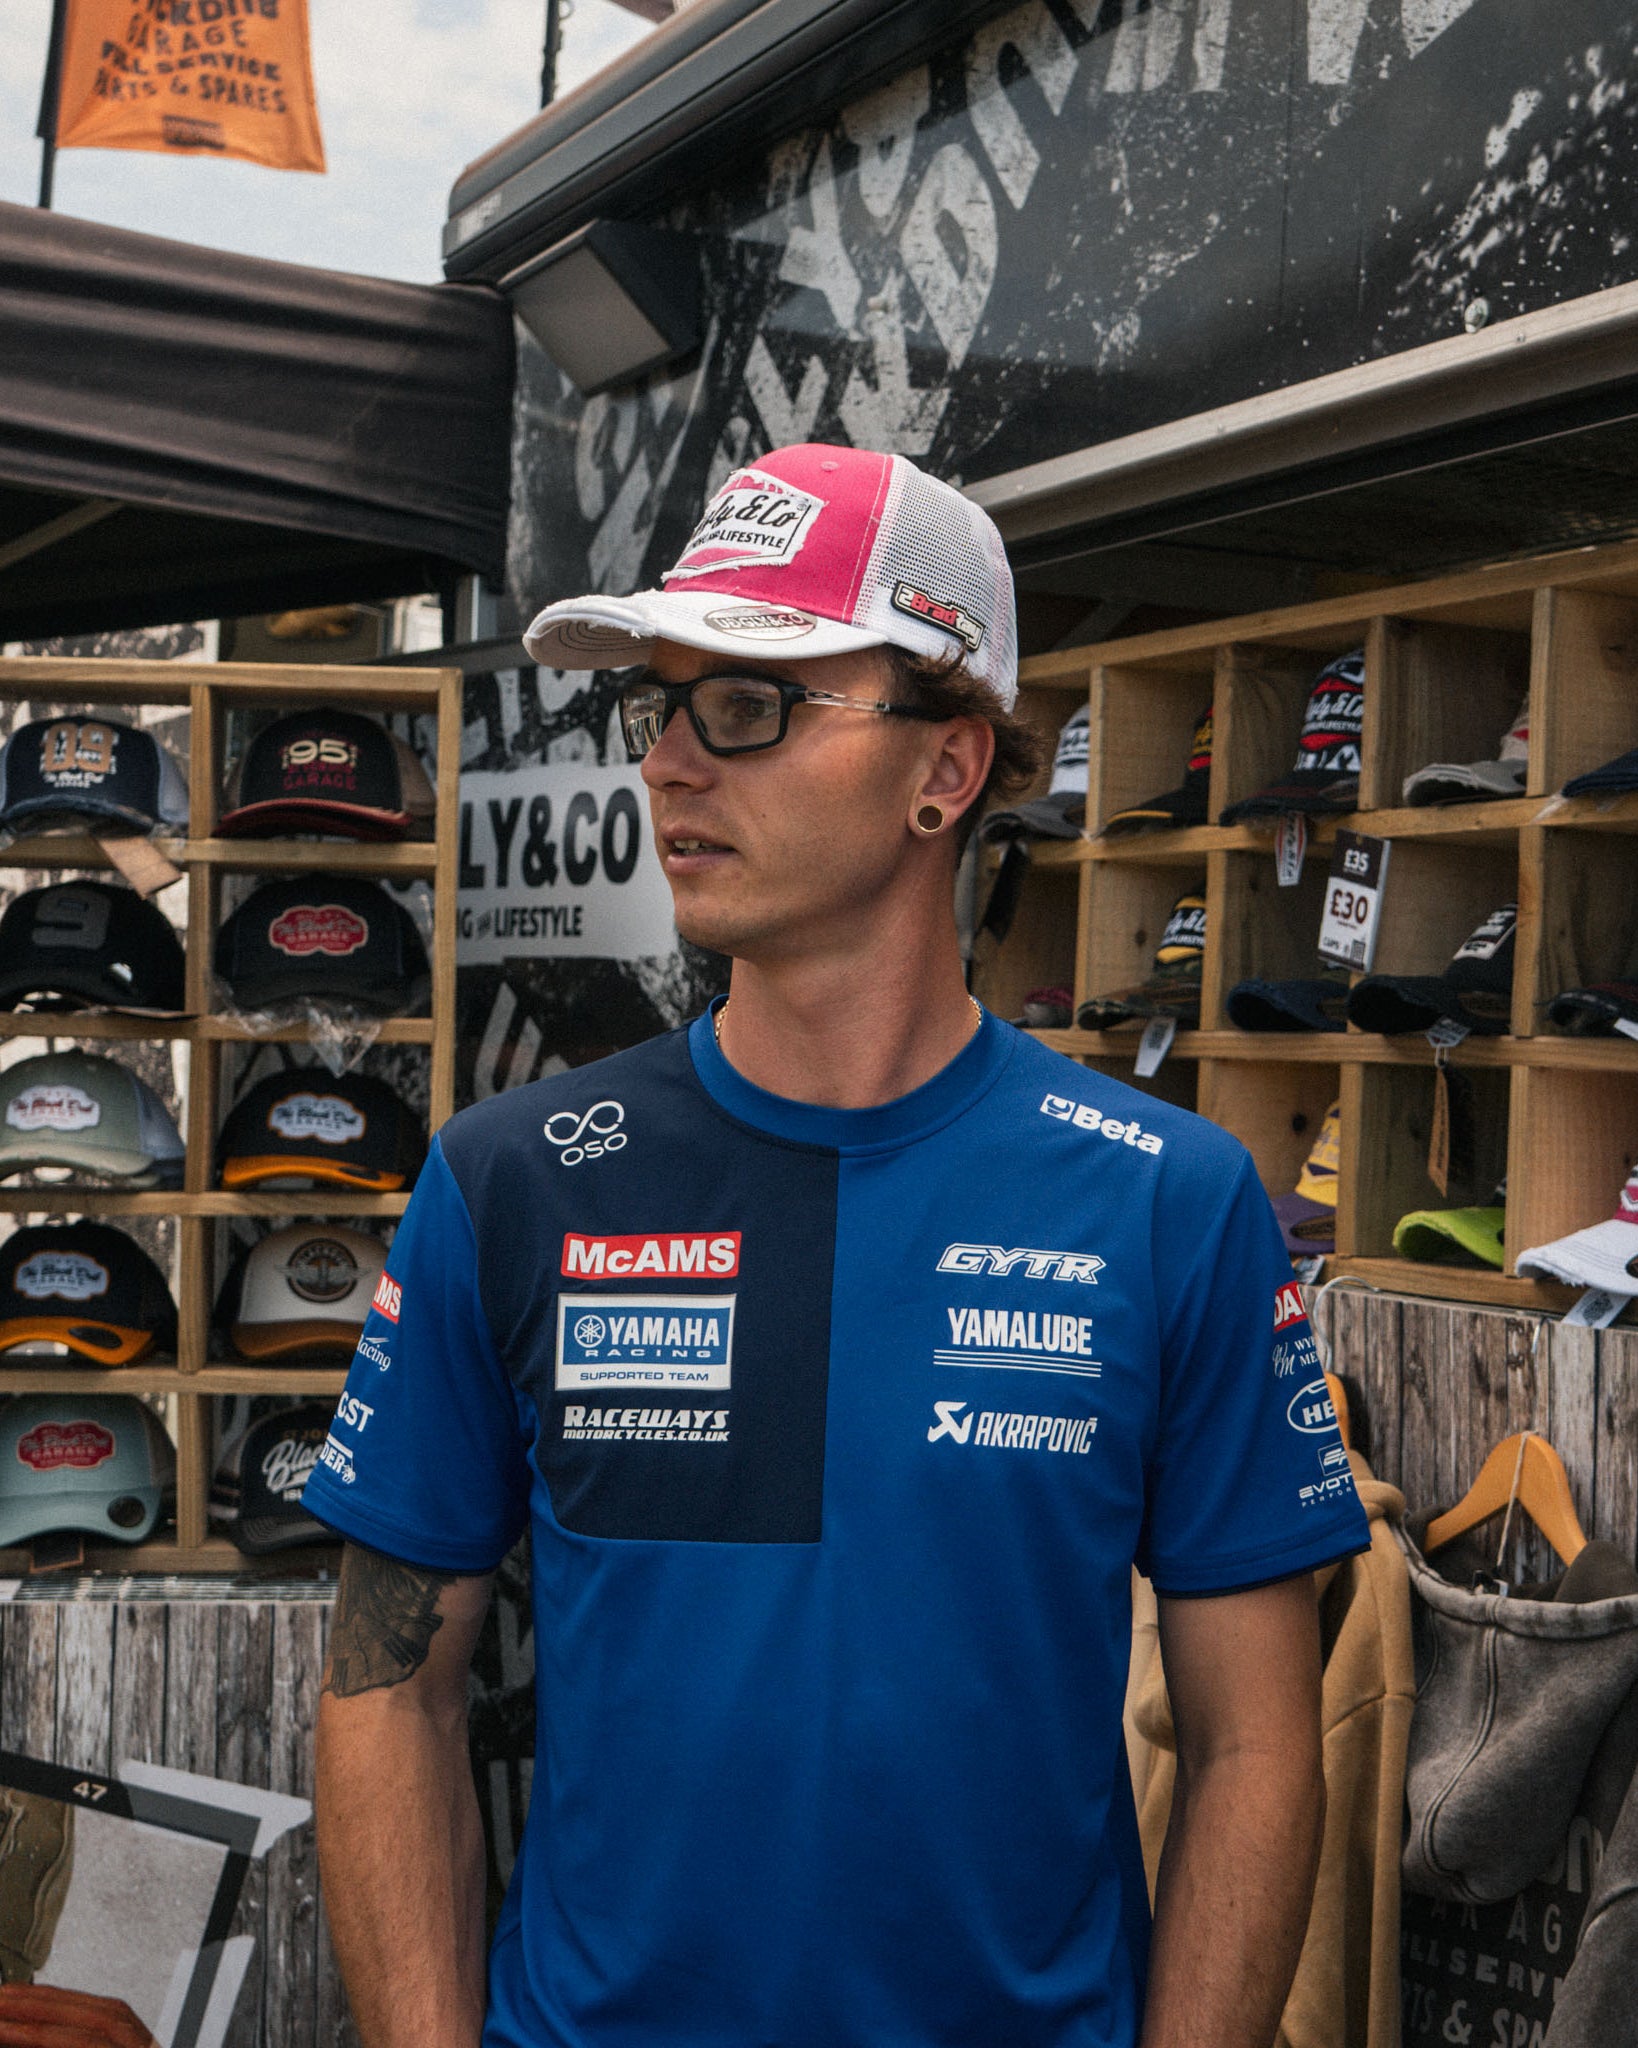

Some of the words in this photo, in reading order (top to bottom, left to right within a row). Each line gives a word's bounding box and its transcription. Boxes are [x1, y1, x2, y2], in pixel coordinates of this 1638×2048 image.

[199, 74, 287, 113] SPARES
[720, 530, 785, 548] LIFESTYLE
[289, 738, 349, 764] 95
[459, 786, 641, 890] LY&CO
[1344, 848, 1369, 873] £35
[494, 906, 583, 938] LIFESTYLE
[1330, 888, 1368, 924] £30
[1072, 1104, 1164, 1155] Beta
[561, 1133, 628, 1166] OSO
[566, 1238, 736, 1274] McAMS
[936, 1242, 1107, 1284] GYTR
[1274, 1285, 1306, 1327] DA
[608, 1316, 720, 1347] YAMAHA
[947, 1308, 1093, 1355] YAMALUBE
[584, 1349, 712, 1358] RACING
[580, 1371, 664, 1381] SUPPORTED
[669, 1372, 709, 1381] TEAM
[563, 1405, 730, 1429] RACEWAYS
[562, 1429, 731, 1442] MOTORCYCLES.CO.UK
[73, 1781, 108, 1801] 47
[1442, 2000, 1474, 2046] &
